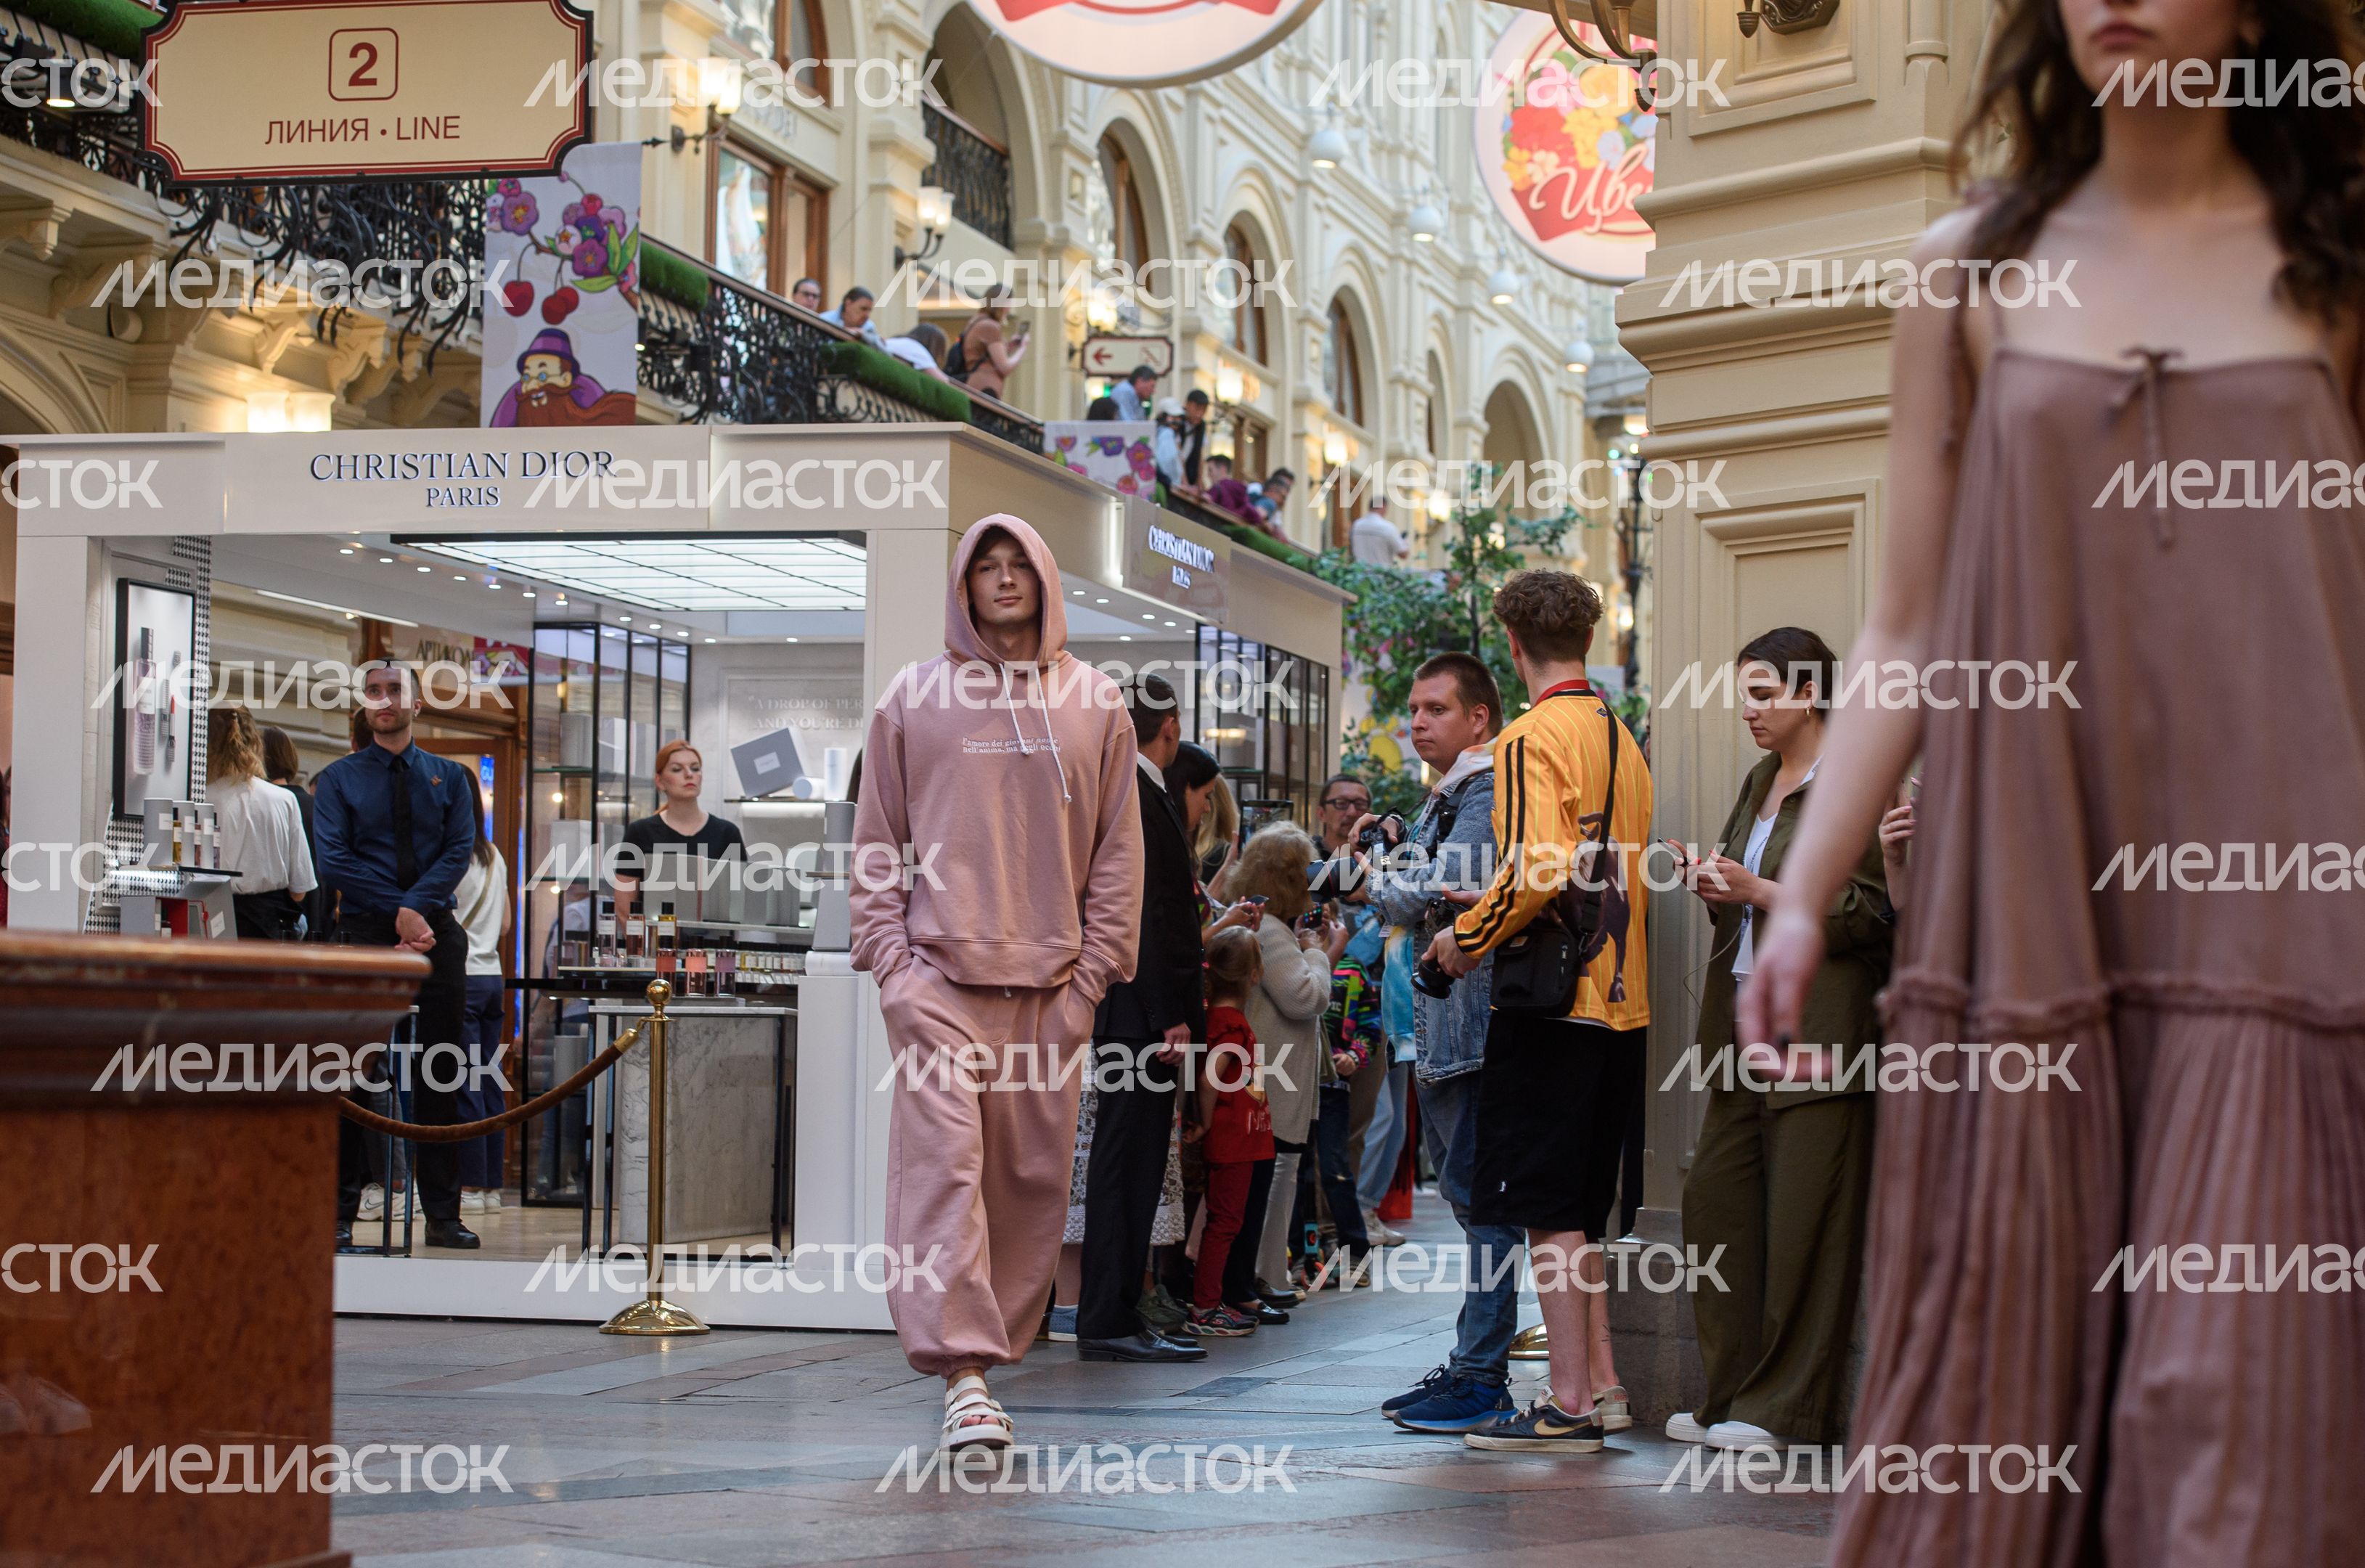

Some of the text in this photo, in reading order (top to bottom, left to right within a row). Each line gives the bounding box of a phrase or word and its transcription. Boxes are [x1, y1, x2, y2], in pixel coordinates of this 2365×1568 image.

[348, 41, 378, 86] 2
[264, 115, 461, 145] ЛИНИЯ LINE
[310, 449, 619, 483] CHRISTIAN DIOR
[425, 486, 502, 508] PARIS
